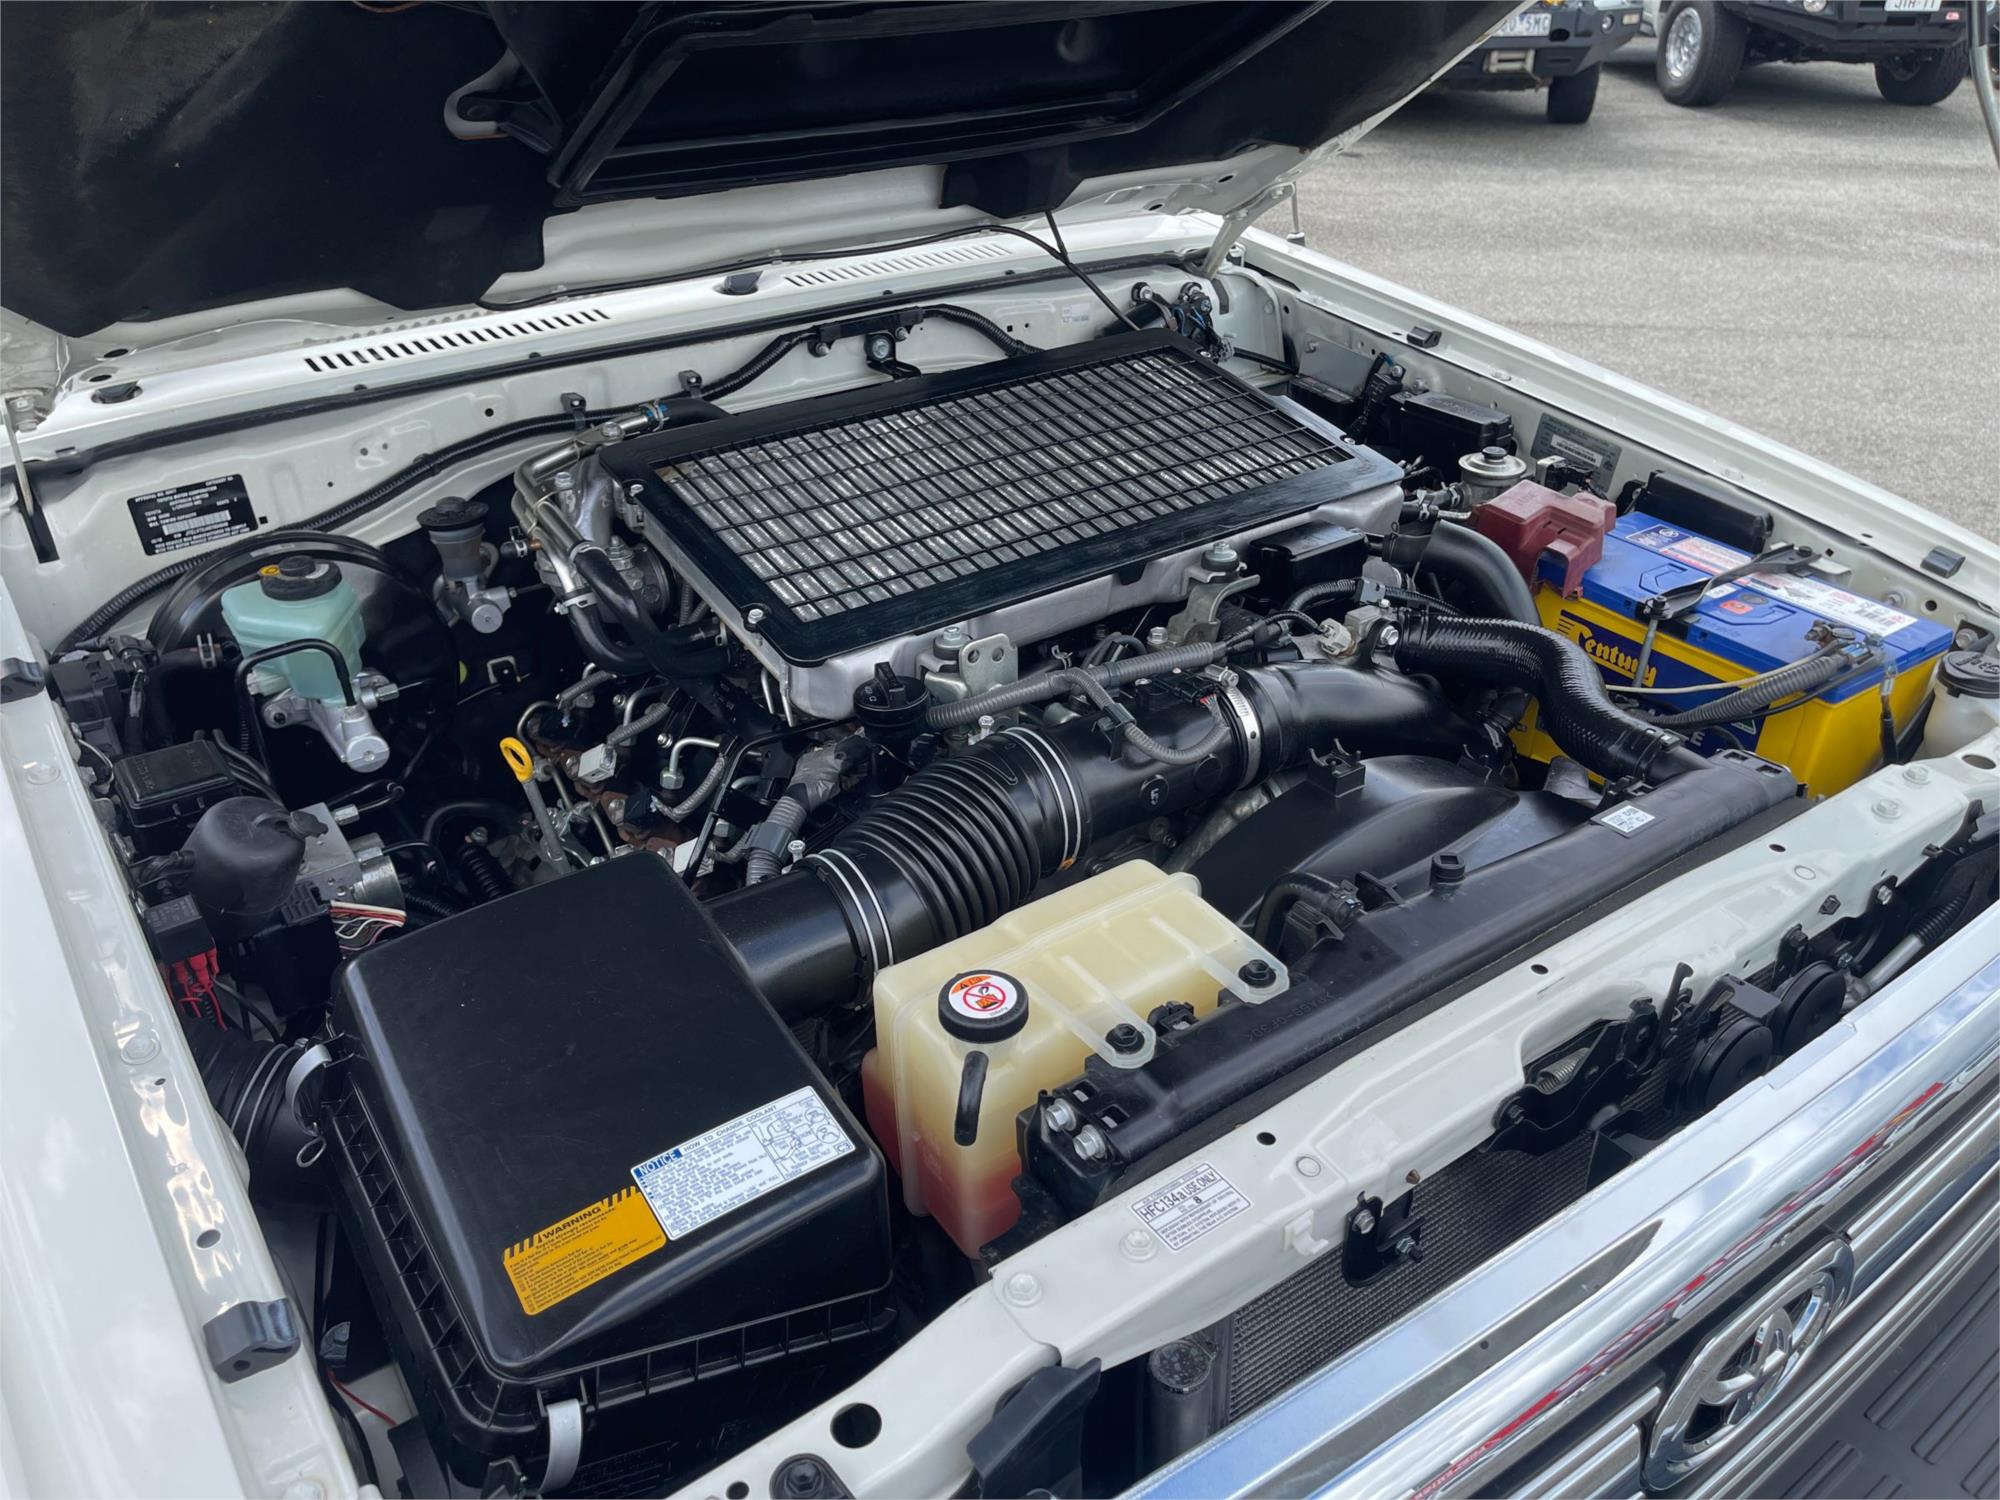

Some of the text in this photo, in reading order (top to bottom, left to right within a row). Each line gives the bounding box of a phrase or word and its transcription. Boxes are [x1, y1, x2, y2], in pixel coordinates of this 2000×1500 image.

[684, 1139, 701, 1153] HOW
[716, 1118, 745, 1137] CHANGE
[746, 1104, 777, 1124] COOLANT
[639, 1150, 679, 1177] NOTICE
[1139, 1188, 1184, 1220] HFC134a
[1182, 1180, 1199, 1195] USE
[1197, 1170, 1218, 1187] ONLY
[544, 1206, 602, 1239] WARNING
